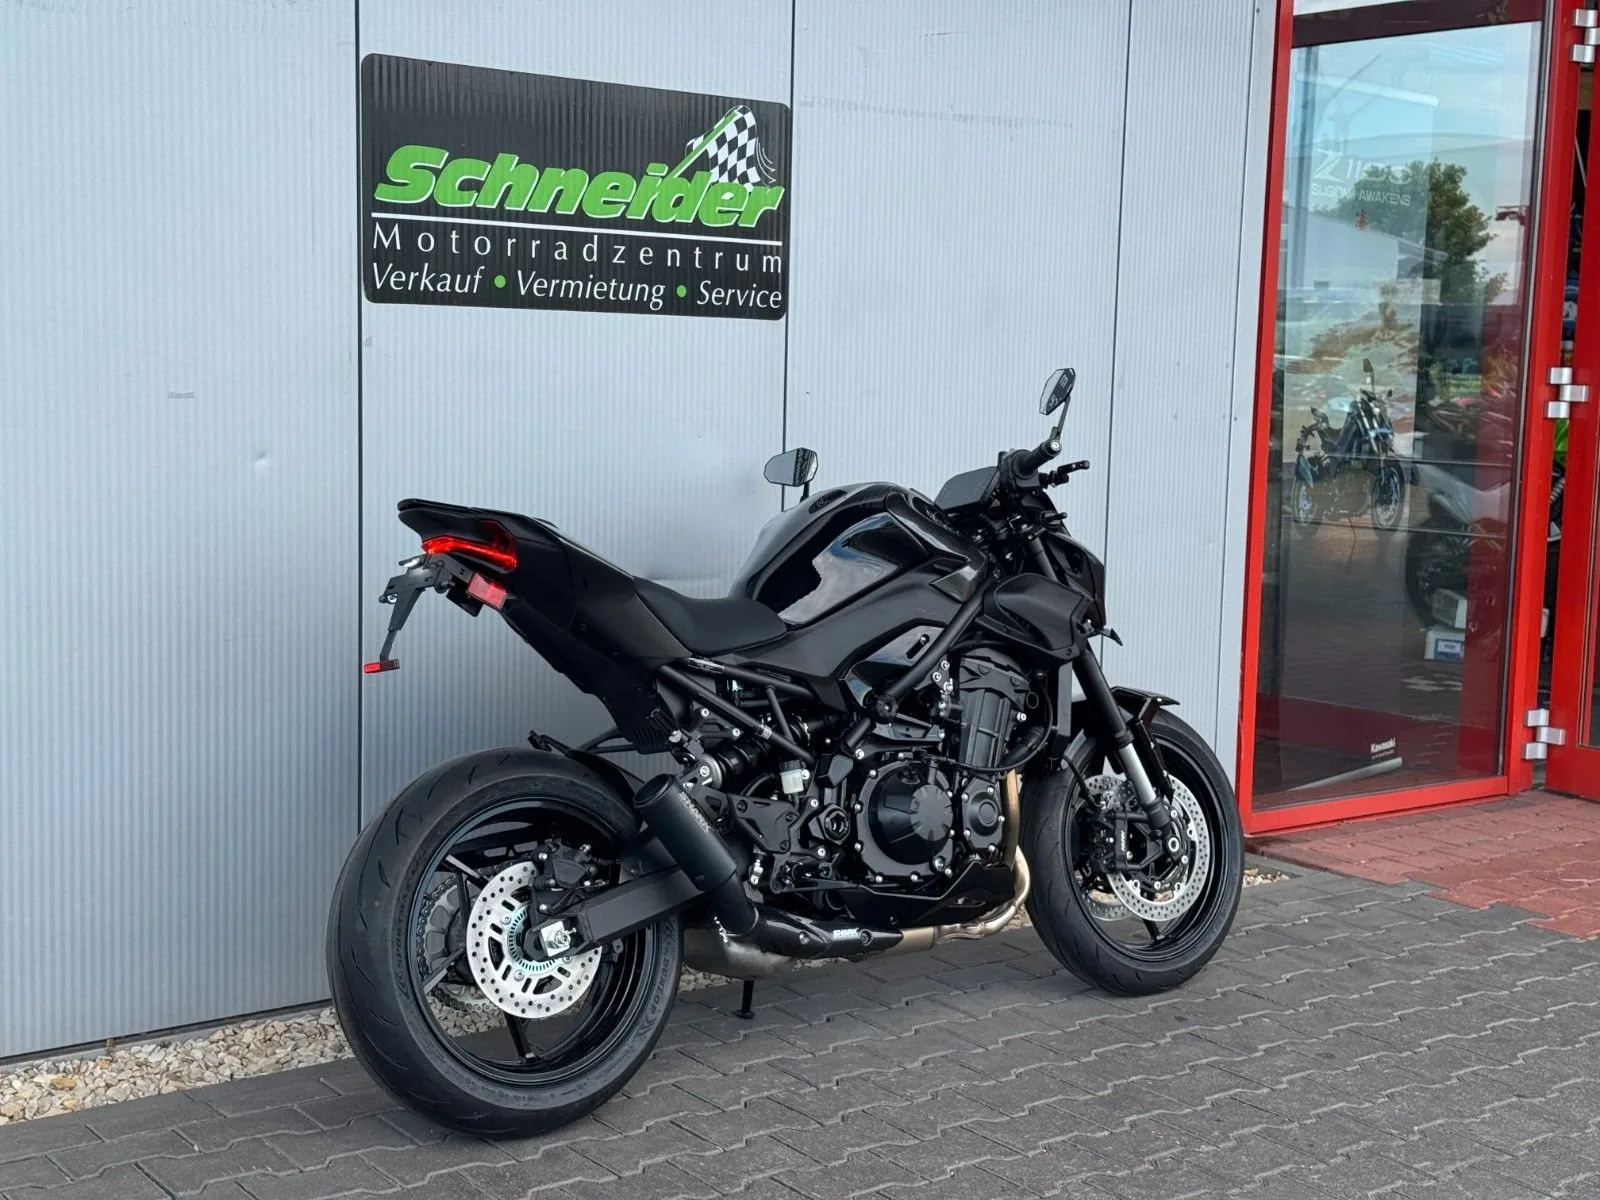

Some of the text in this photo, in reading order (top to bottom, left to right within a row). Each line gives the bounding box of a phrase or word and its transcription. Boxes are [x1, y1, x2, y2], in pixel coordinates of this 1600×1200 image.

[374, 144, 785, 229] Schneider
[1358, 189, 1412, 207] AWAKENS
[372, 221, 783, 274] Motorradzentrum
[372, 261, 783, 311] Verkauf Vermietung Service
[679, 791, 711, 834] SHARK
[649, 958, 670, 1015] DUNLOP
